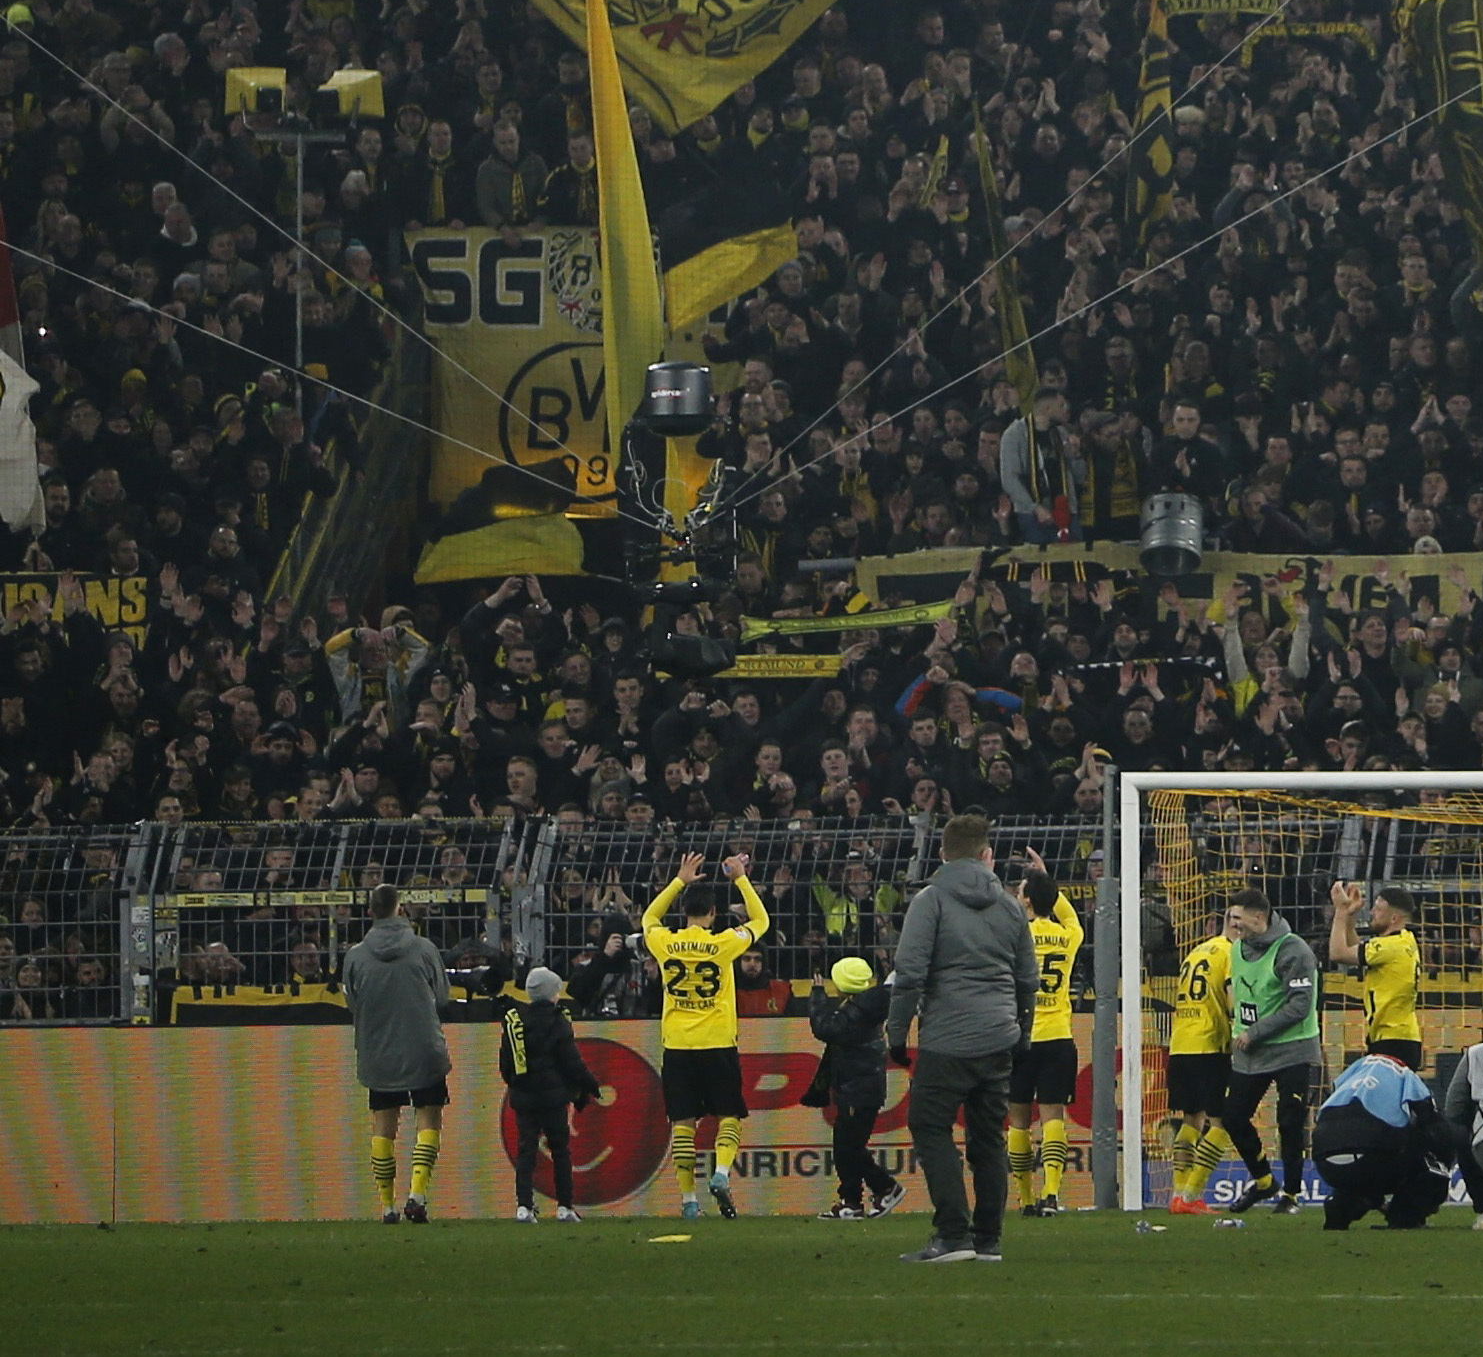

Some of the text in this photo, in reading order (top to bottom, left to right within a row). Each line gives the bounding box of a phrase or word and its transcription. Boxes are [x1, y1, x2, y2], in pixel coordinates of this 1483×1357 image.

[411, 236, 544, 327] SG
[526, 357, 613, 457] BV
[666, 941, 720, 955] DORTMUND
[664, 958, 720, 998] 23
[674, 999, 716, 1009] EMRE CAN
